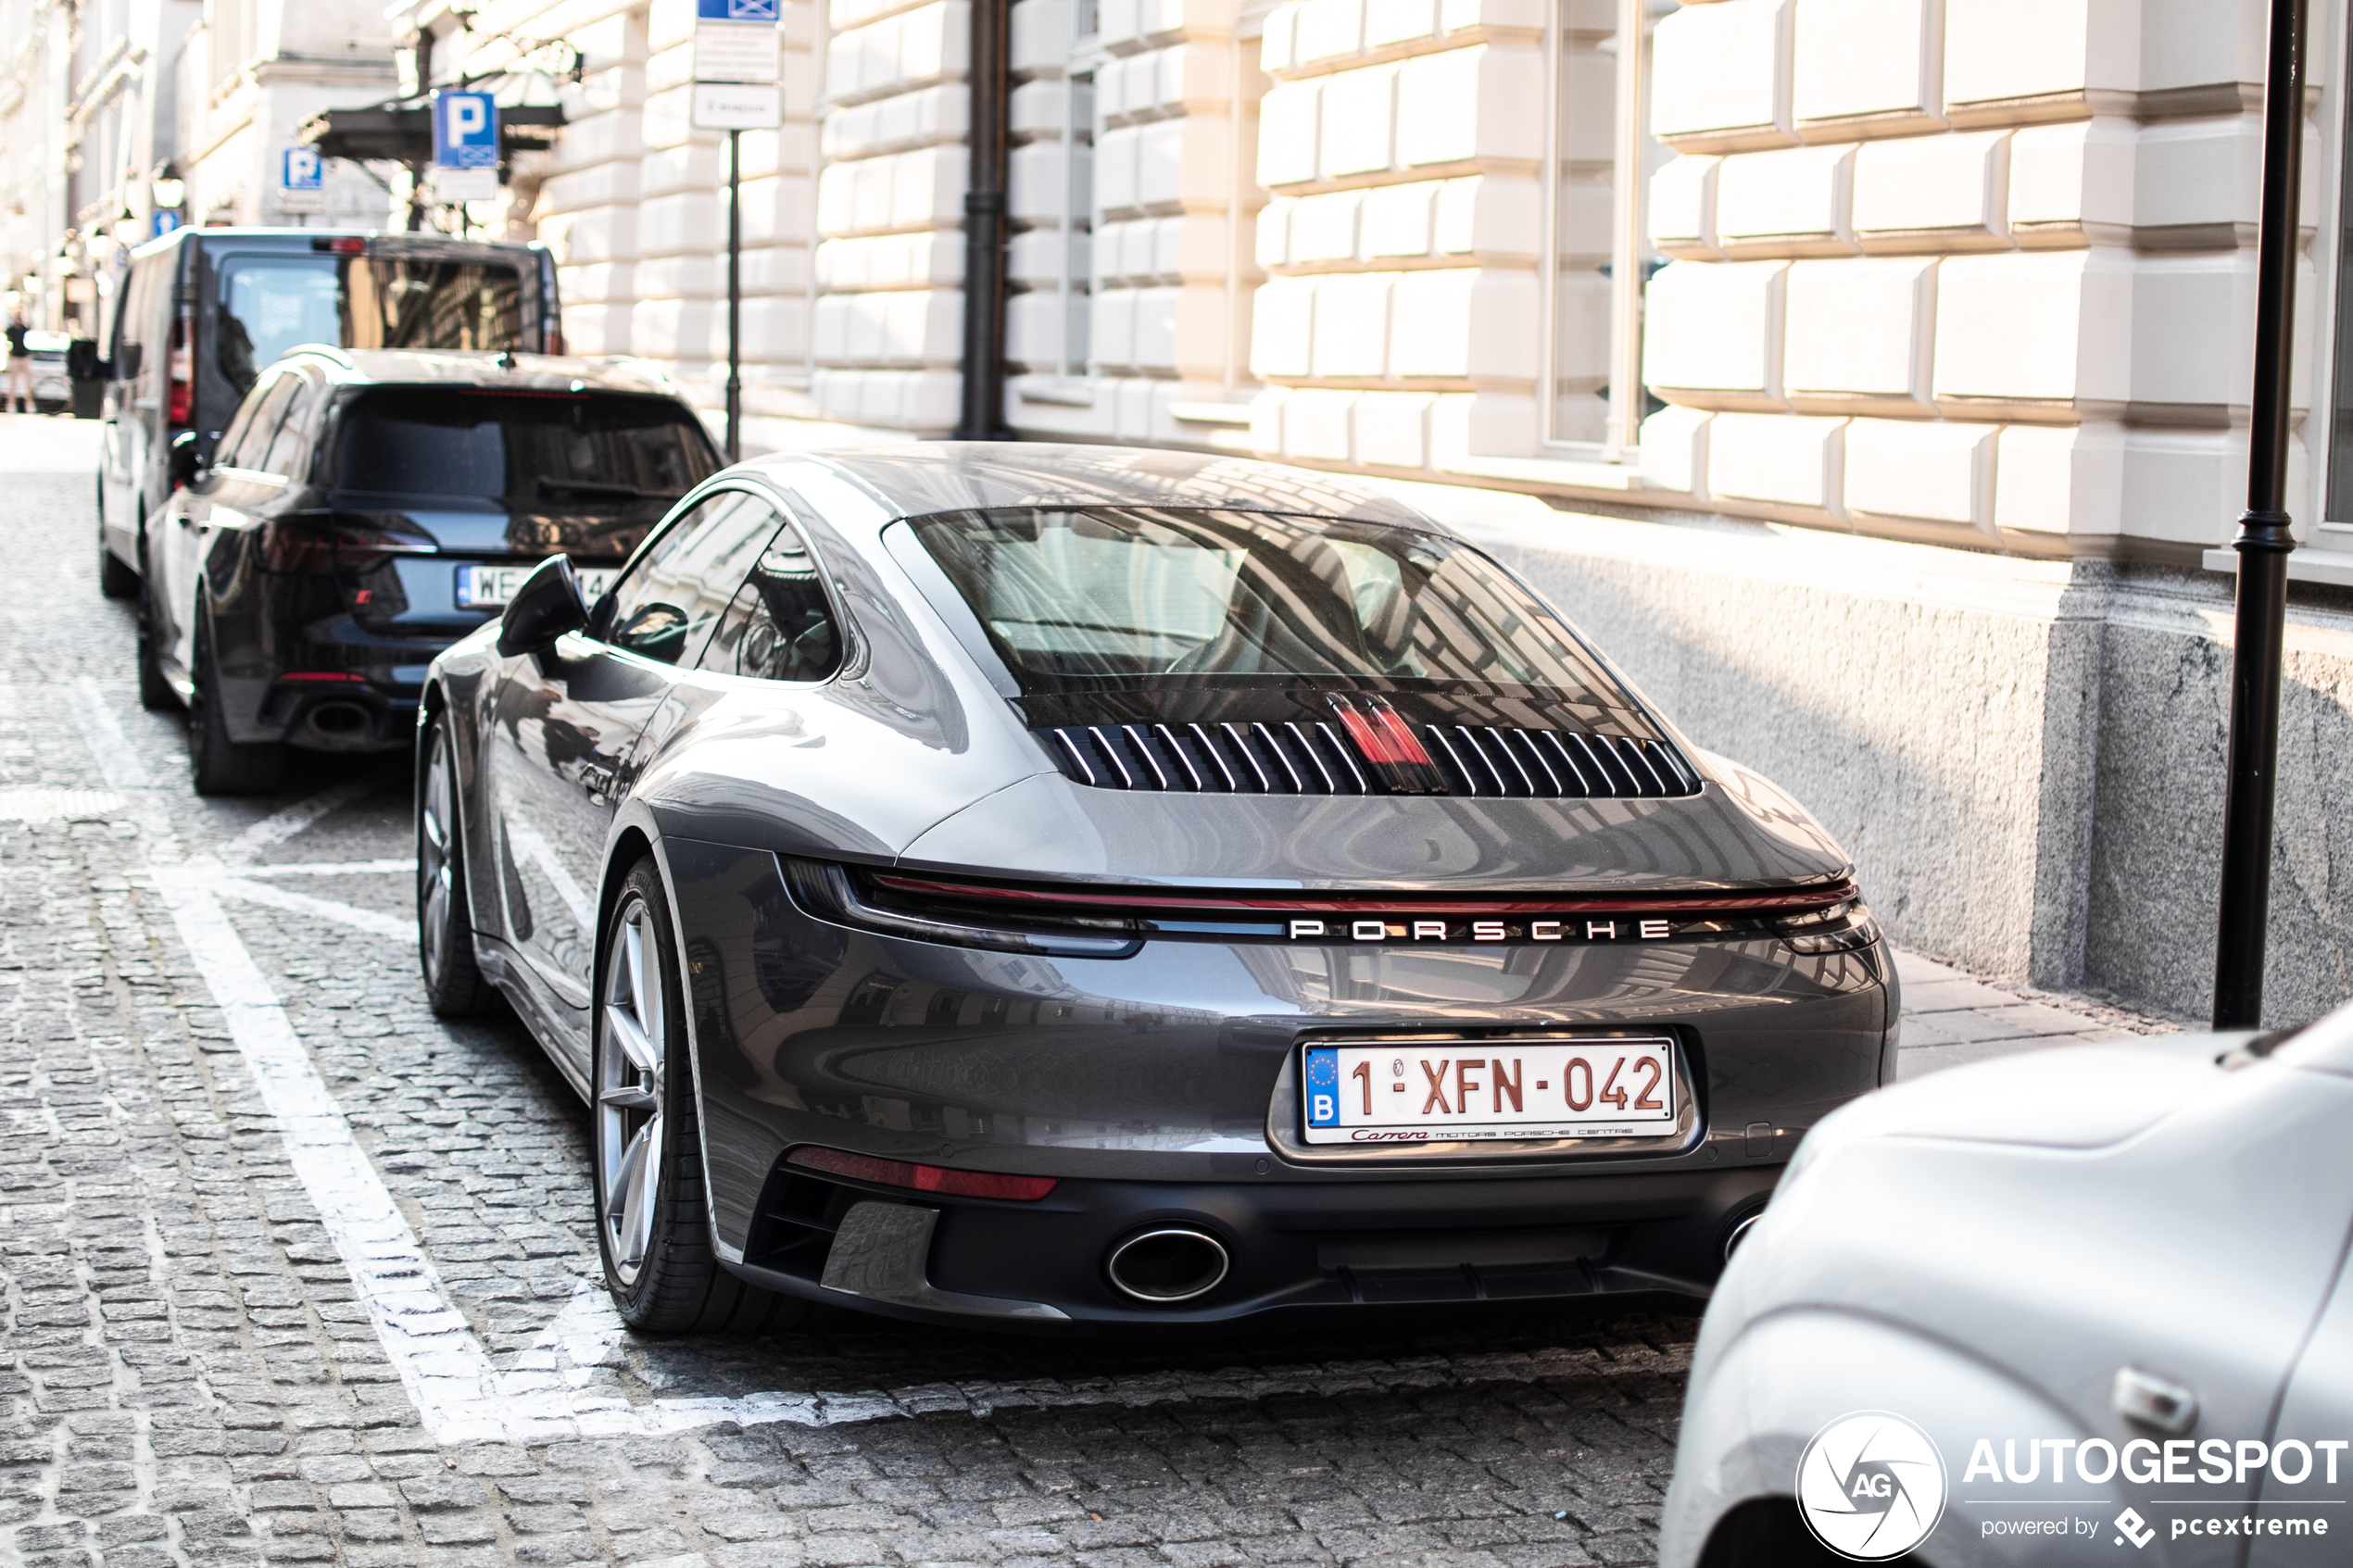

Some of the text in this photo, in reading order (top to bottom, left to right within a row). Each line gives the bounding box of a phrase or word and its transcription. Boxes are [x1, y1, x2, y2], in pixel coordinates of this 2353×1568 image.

[447, 95, 486, 148] P
[288, 150, 319, 184] P
[479, 571, 516, 599] WE
[1290, 919, 1669, 941] PORSCHE
[1314, 1094, 1334, 1122] B
[1351, 1129, 1430, 1141] Carrera
